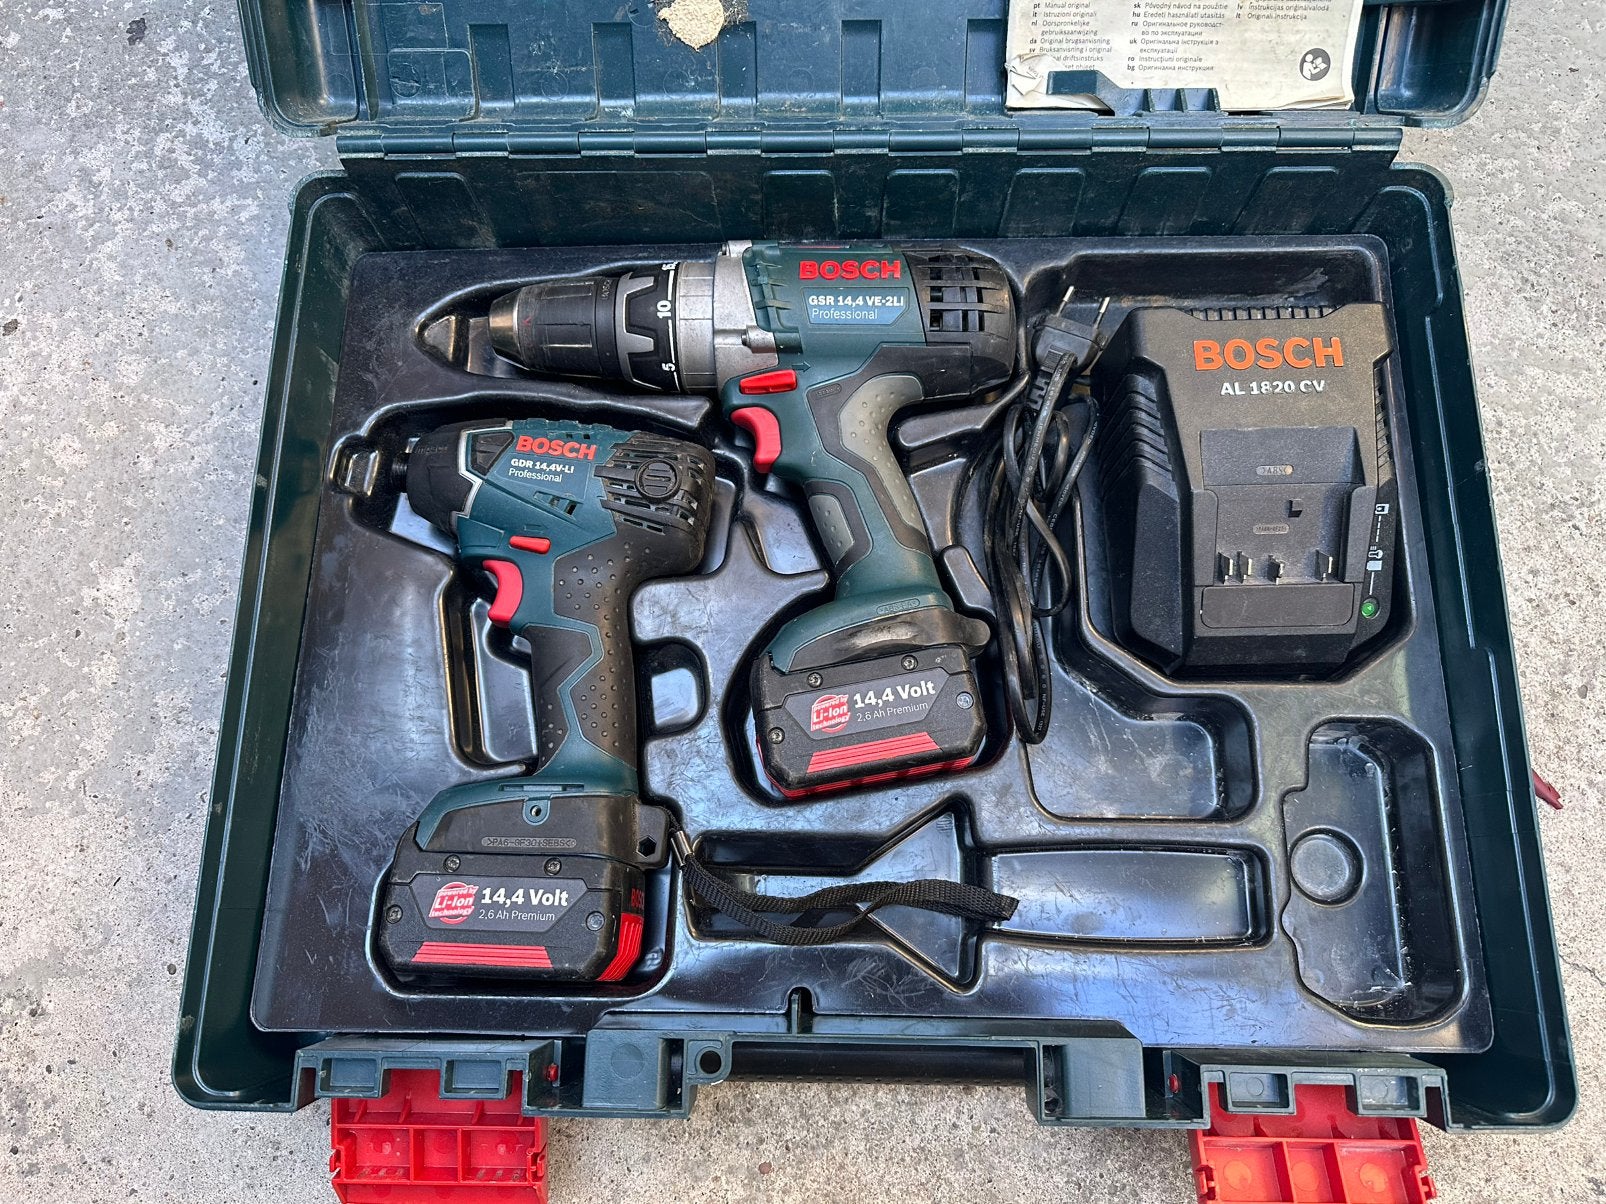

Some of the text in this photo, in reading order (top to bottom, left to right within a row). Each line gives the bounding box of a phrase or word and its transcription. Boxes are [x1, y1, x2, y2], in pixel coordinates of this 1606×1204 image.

[1072, 11, 1097, 19] originali
[1040, 37, 1064, 45] Original
[799, 260, 901, 280] BOSCH
[808, 295, 835, 306] GSR
[837, 295, 864, 308] 14,4
[656, 300, 672, 319] 10
[812, 308, 878, 320] Professional
[1193, 336, 1344, 371] BOSCH
[662, 362, 676, 372] 5
[1220, 379, 1326, 396] AL 1820 CV
[516, 436, 597, 460] BOSCH
[510, 458, 534, 469] GDR
[508, 467, 563, 483] Professional
[853, 680, 936, 709] 14,4 Volt
[813, 698, 840, 712] powered
[873, 708, 886, 719] Ah
[887, 702, 929, 717] Premium
[812, 712, 851, 730] technology
[813, 705, 848, 723] Li-Ion
[438, 888, 467, 897] powered
[481, 887, 569, 908] 14,4 Volt
[434, 895, 475, 909] Li-Ion
[431, 905, 475, 917] technology
[496, 910, 510, 920] Ah
[511, 910, 556, 921] Premium
